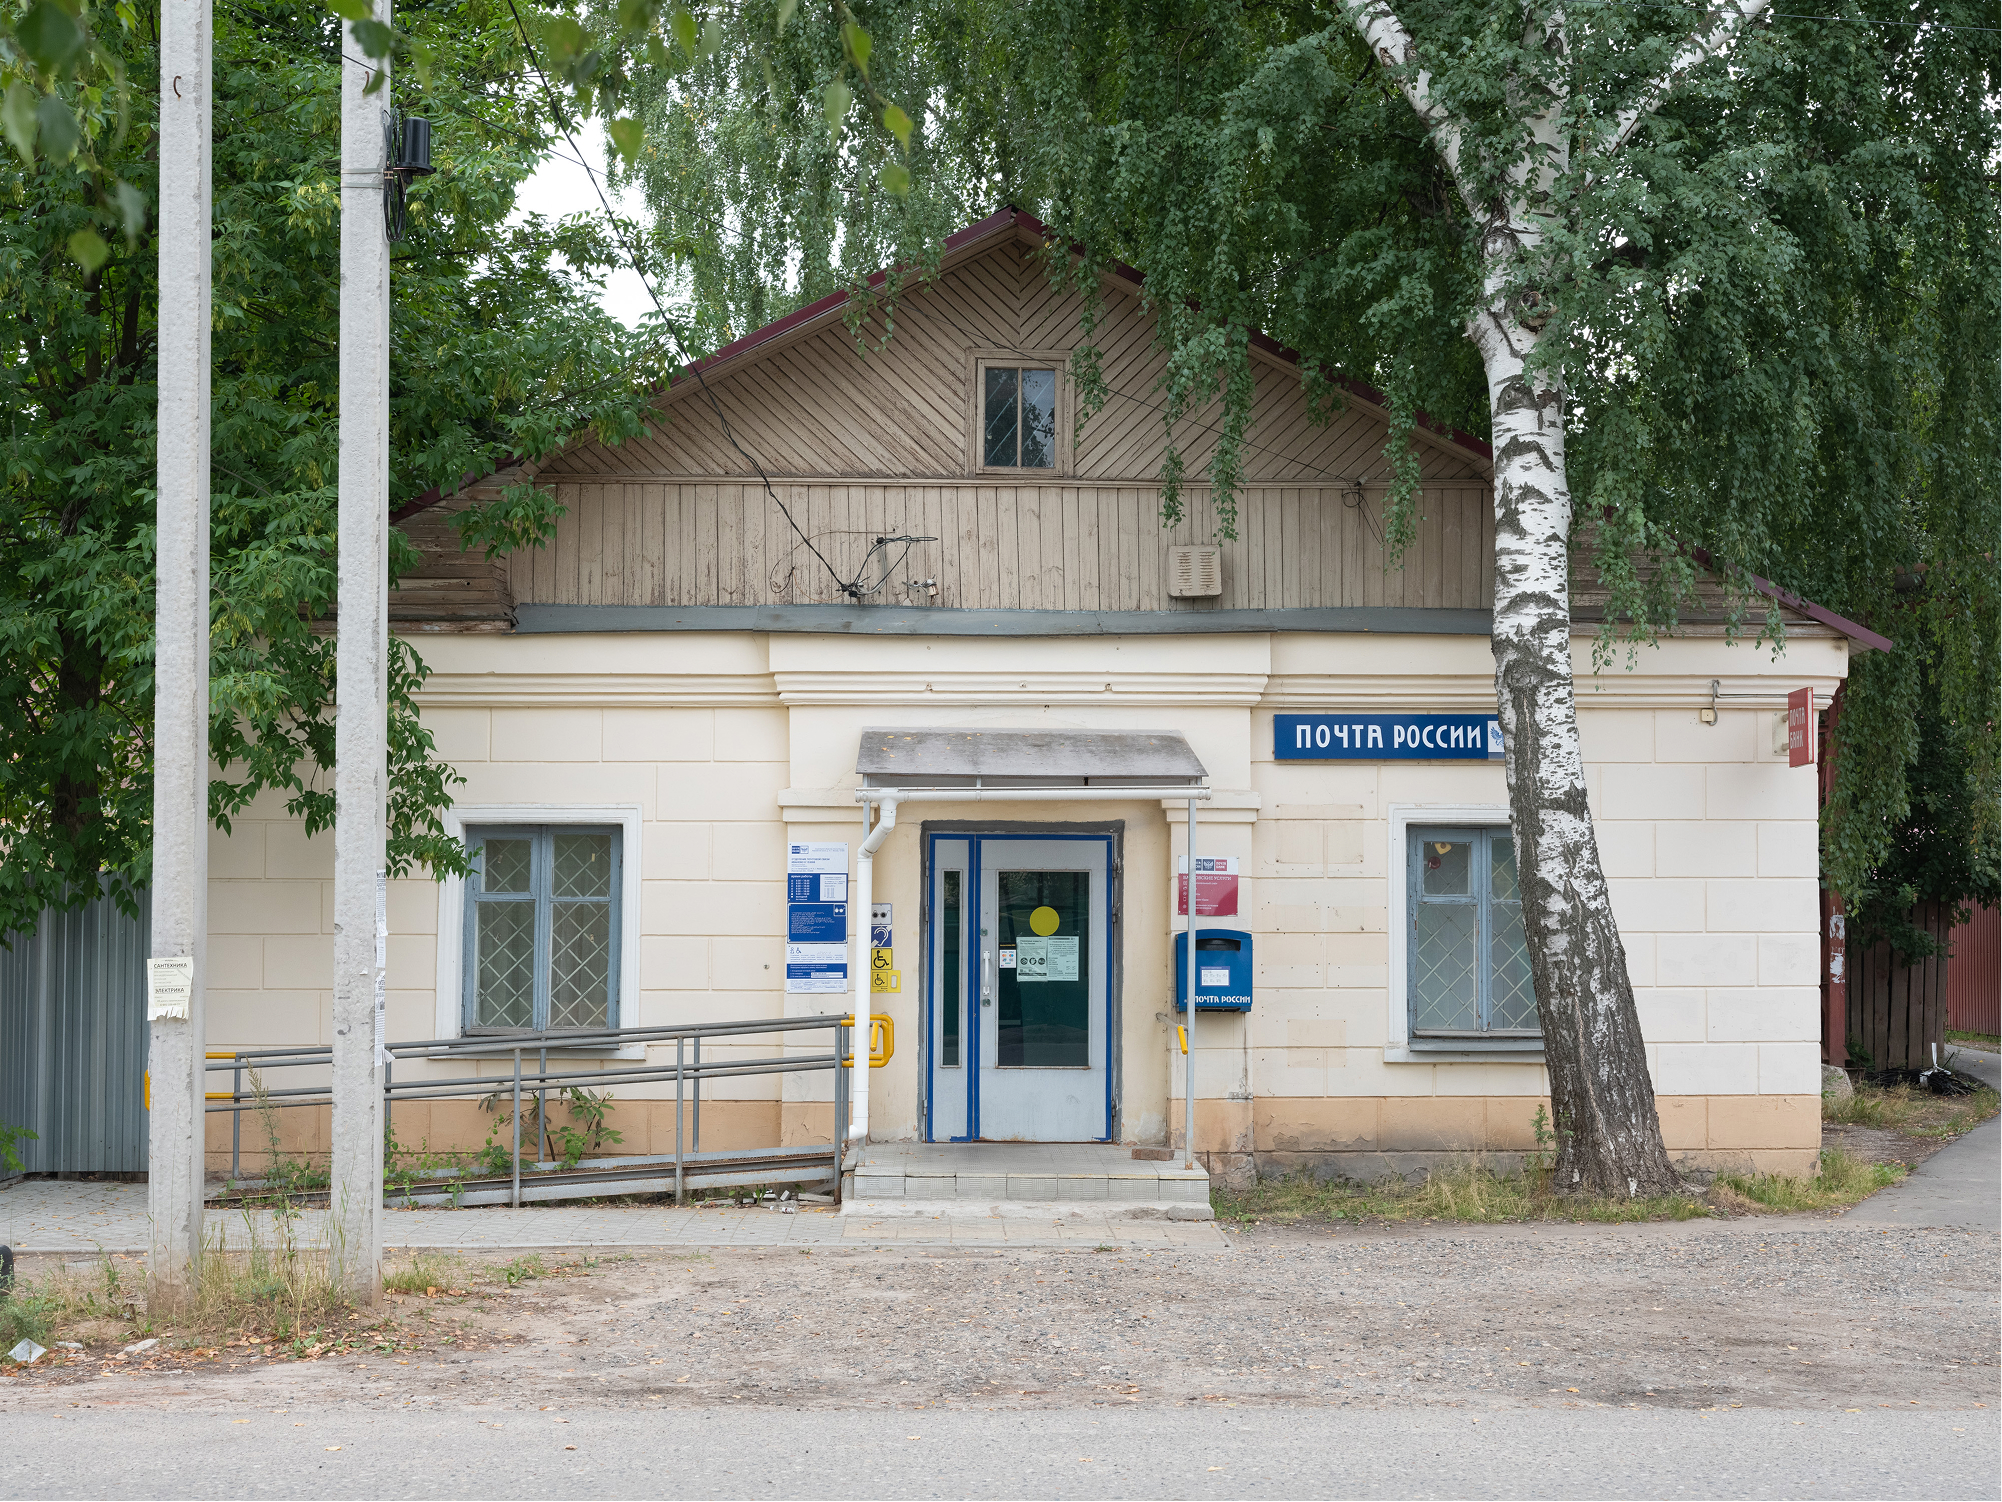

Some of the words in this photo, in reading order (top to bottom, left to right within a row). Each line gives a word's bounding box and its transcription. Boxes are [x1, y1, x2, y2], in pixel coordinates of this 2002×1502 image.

[1789, 707, 1805, 727] ПОЧТА
[1296, 725, 1383, 748] ПОЧТА
[1394, 725, 1481, 748] РОССИИ
[1790, 730, 1803, 749] БАНК
